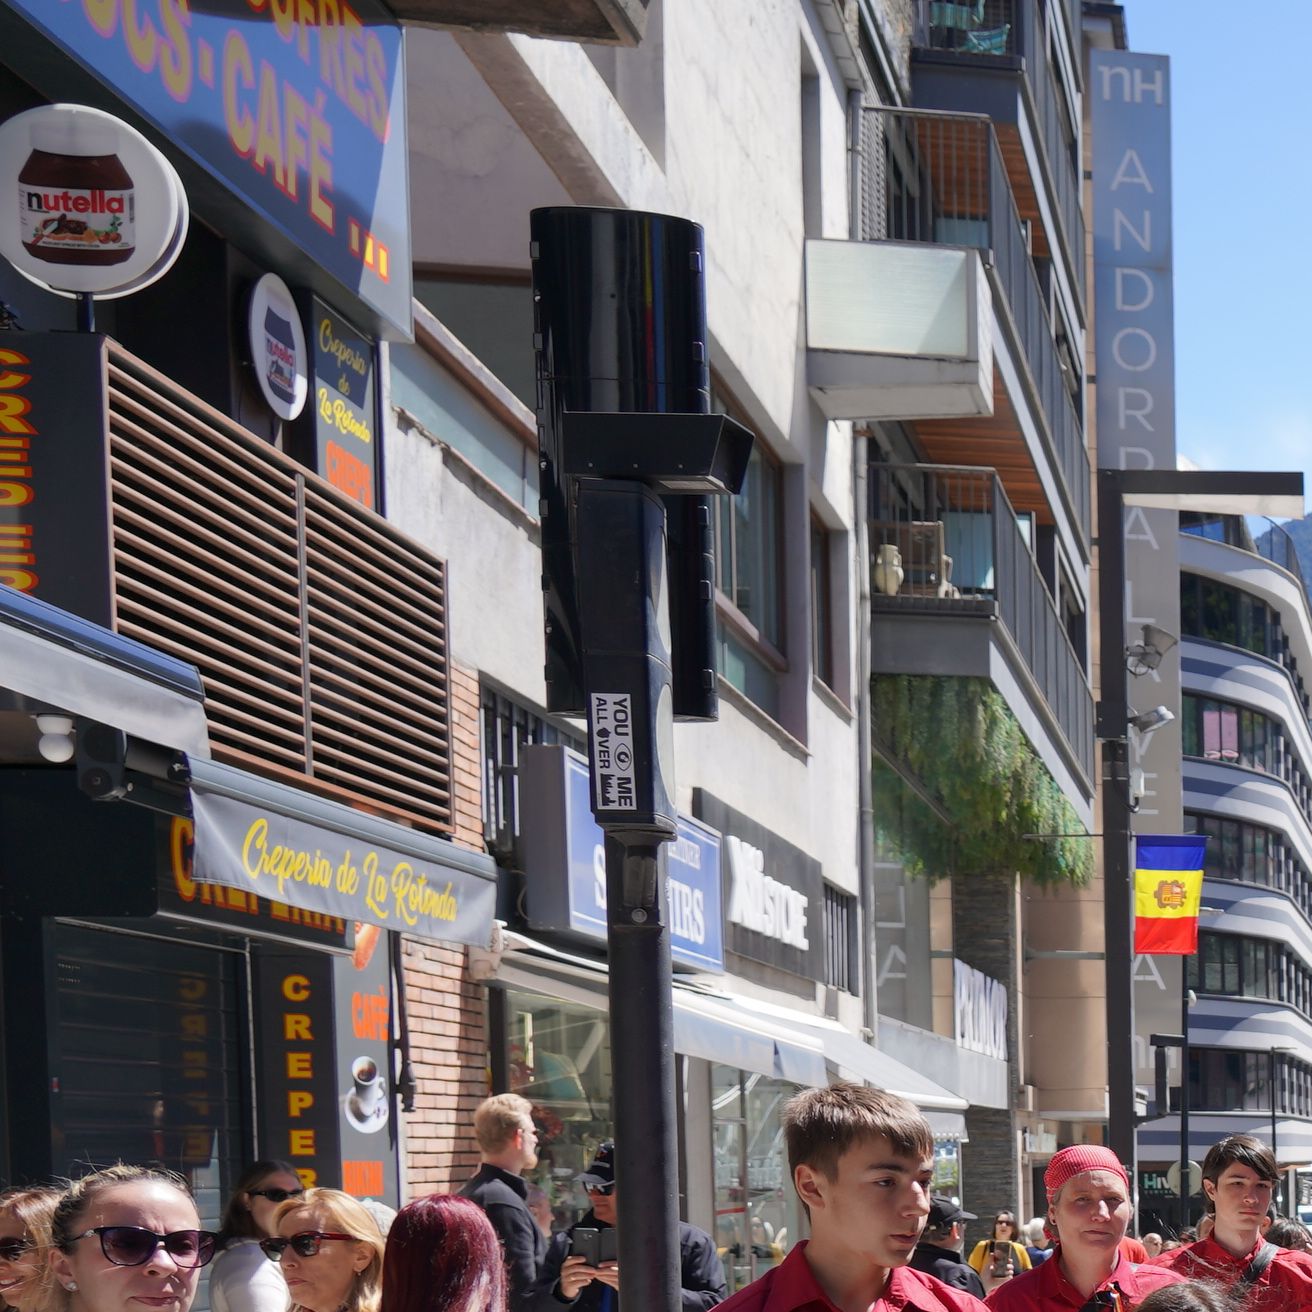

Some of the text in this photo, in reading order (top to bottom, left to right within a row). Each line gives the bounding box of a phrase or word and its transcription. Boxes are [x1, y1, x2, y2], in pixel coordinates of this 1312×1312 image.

[27, 187, 125, 213] nutella
[595, 696, 610, 725] ALL
[613, 697, 634, 807] YOU ME
[242, 818, 332, 895] Creperia
[336, 848, 360, 895] de
[362, 852, 389, 919] La
[390, 862, 458, 926] Rotonda
